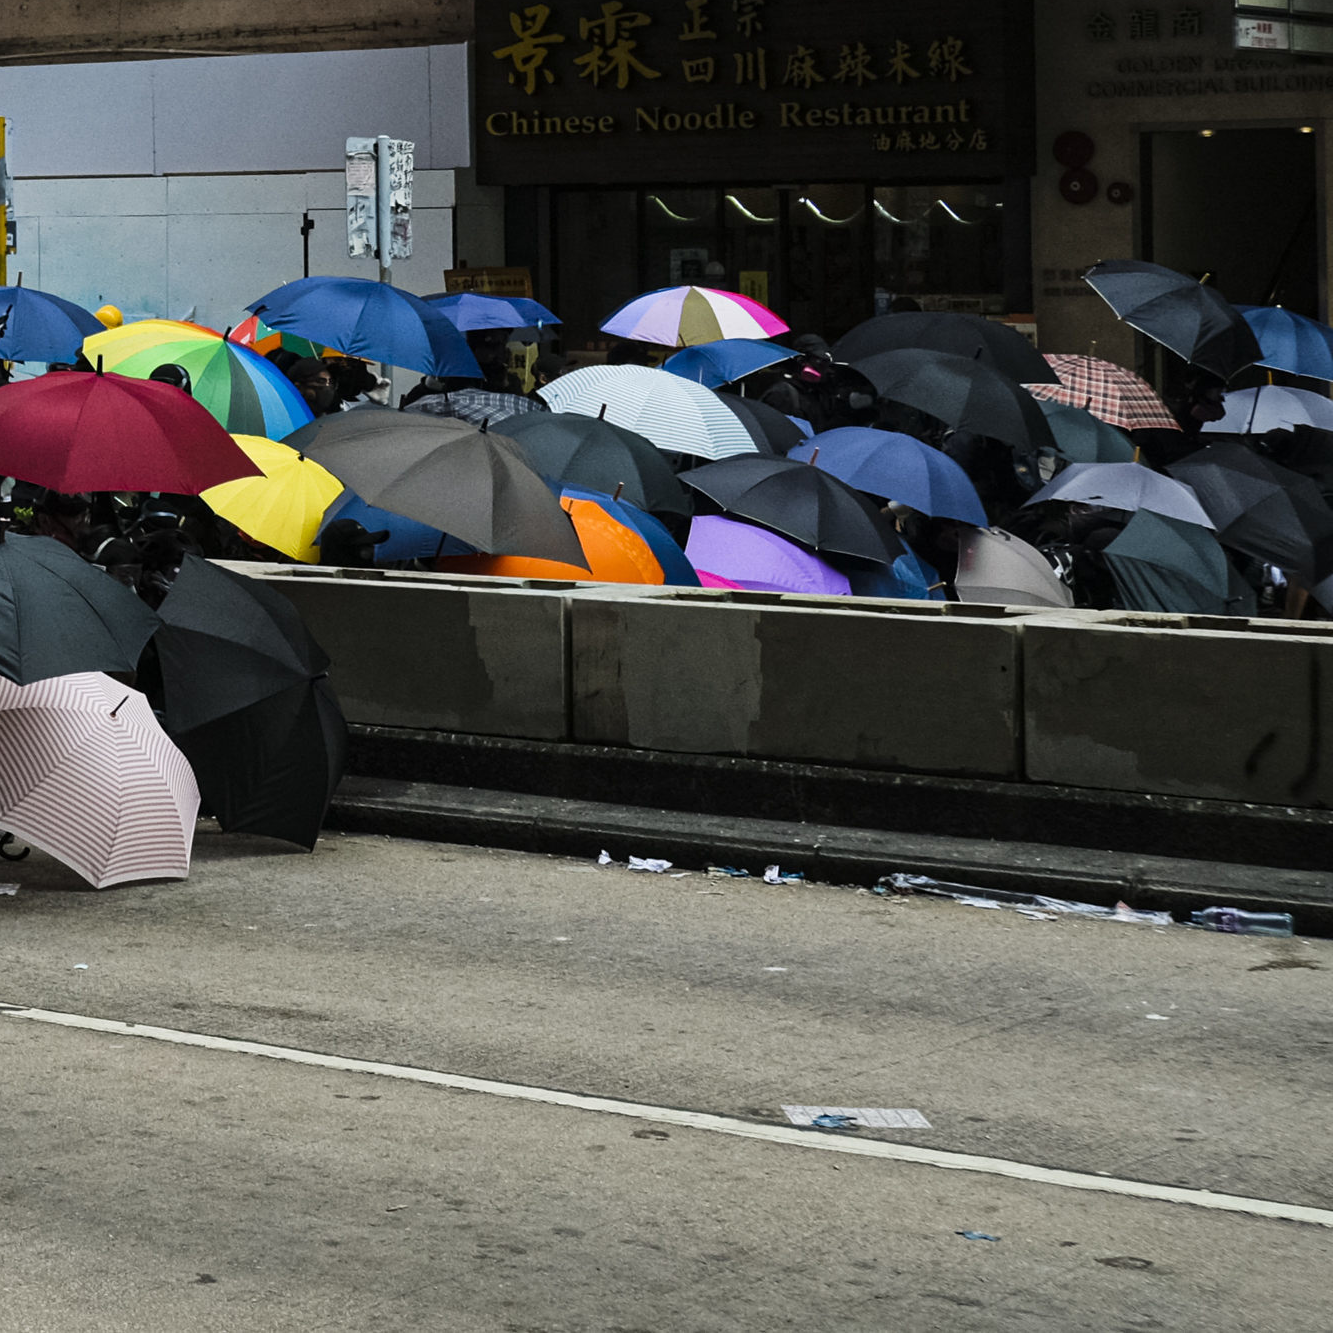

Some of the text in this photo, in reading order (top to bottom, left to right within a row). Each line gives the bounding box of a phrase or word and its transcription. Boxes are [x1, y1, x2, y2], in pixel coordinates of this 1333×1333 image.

[680, 35, 976, 92] 四川麻辣米線
[484, 97, 972, 137] Chinese Noodle Restaurant
